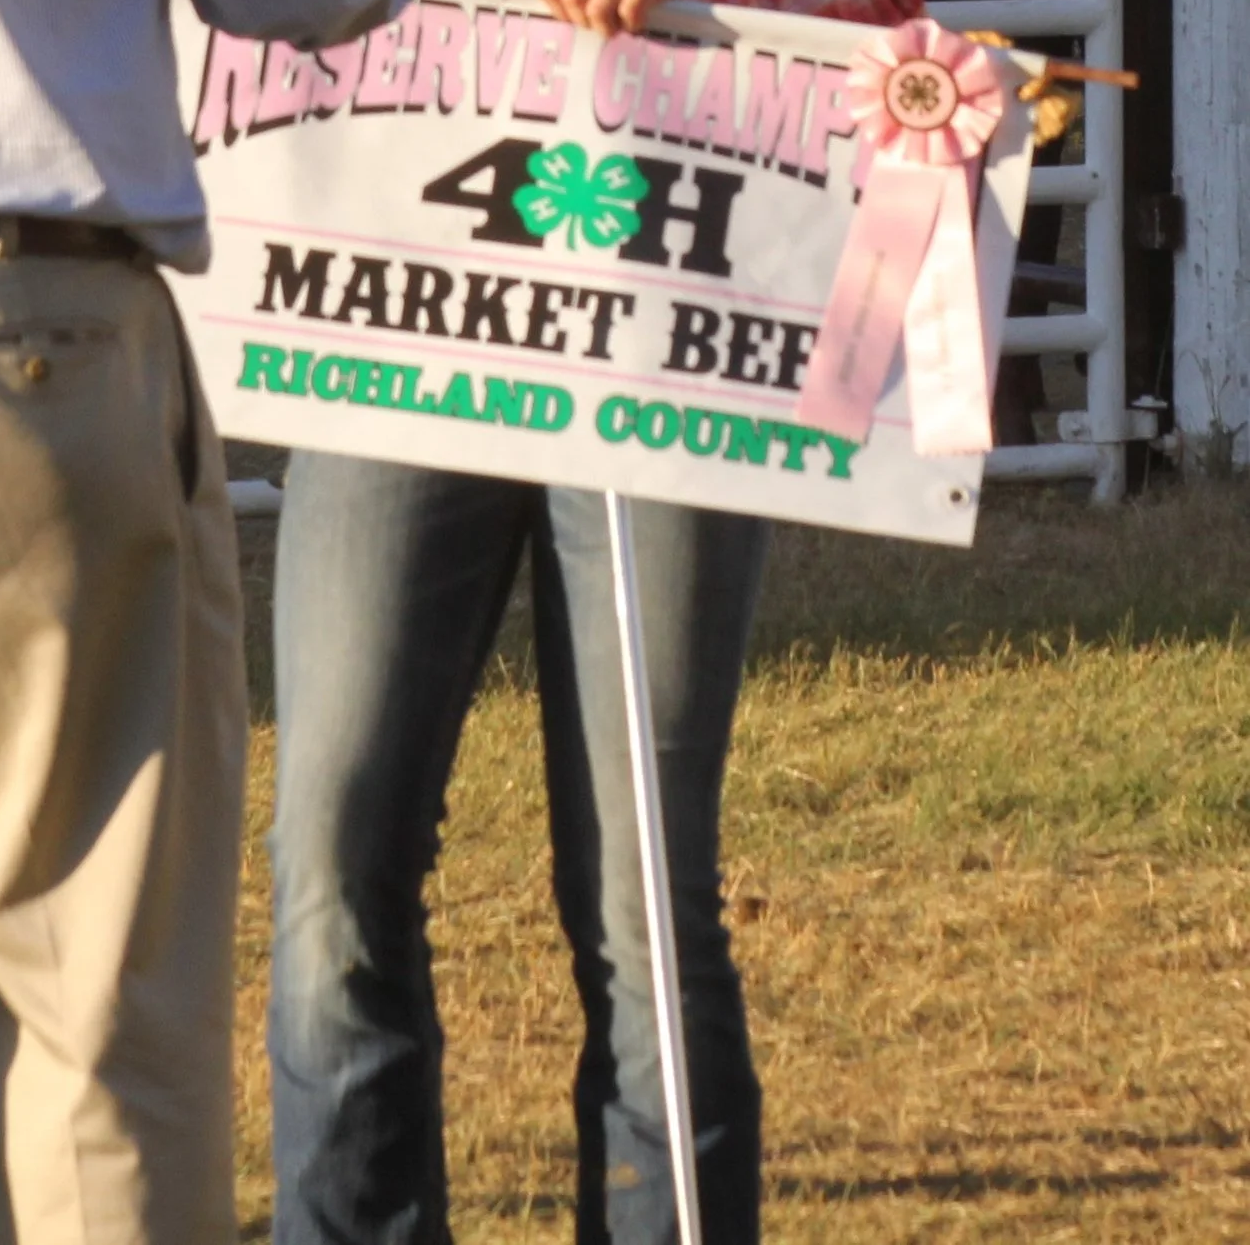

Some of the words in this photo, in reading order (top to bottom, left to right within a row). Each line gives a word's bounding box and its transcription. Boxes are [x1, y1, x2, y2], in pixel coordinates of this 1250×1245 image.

[593, 29, 882, 205] CHAMP
[255, 242, 636, 360] MARKET
[237, 342, 574, 433] RICHLAND
[596, 395, 862, 479] COUNTY
